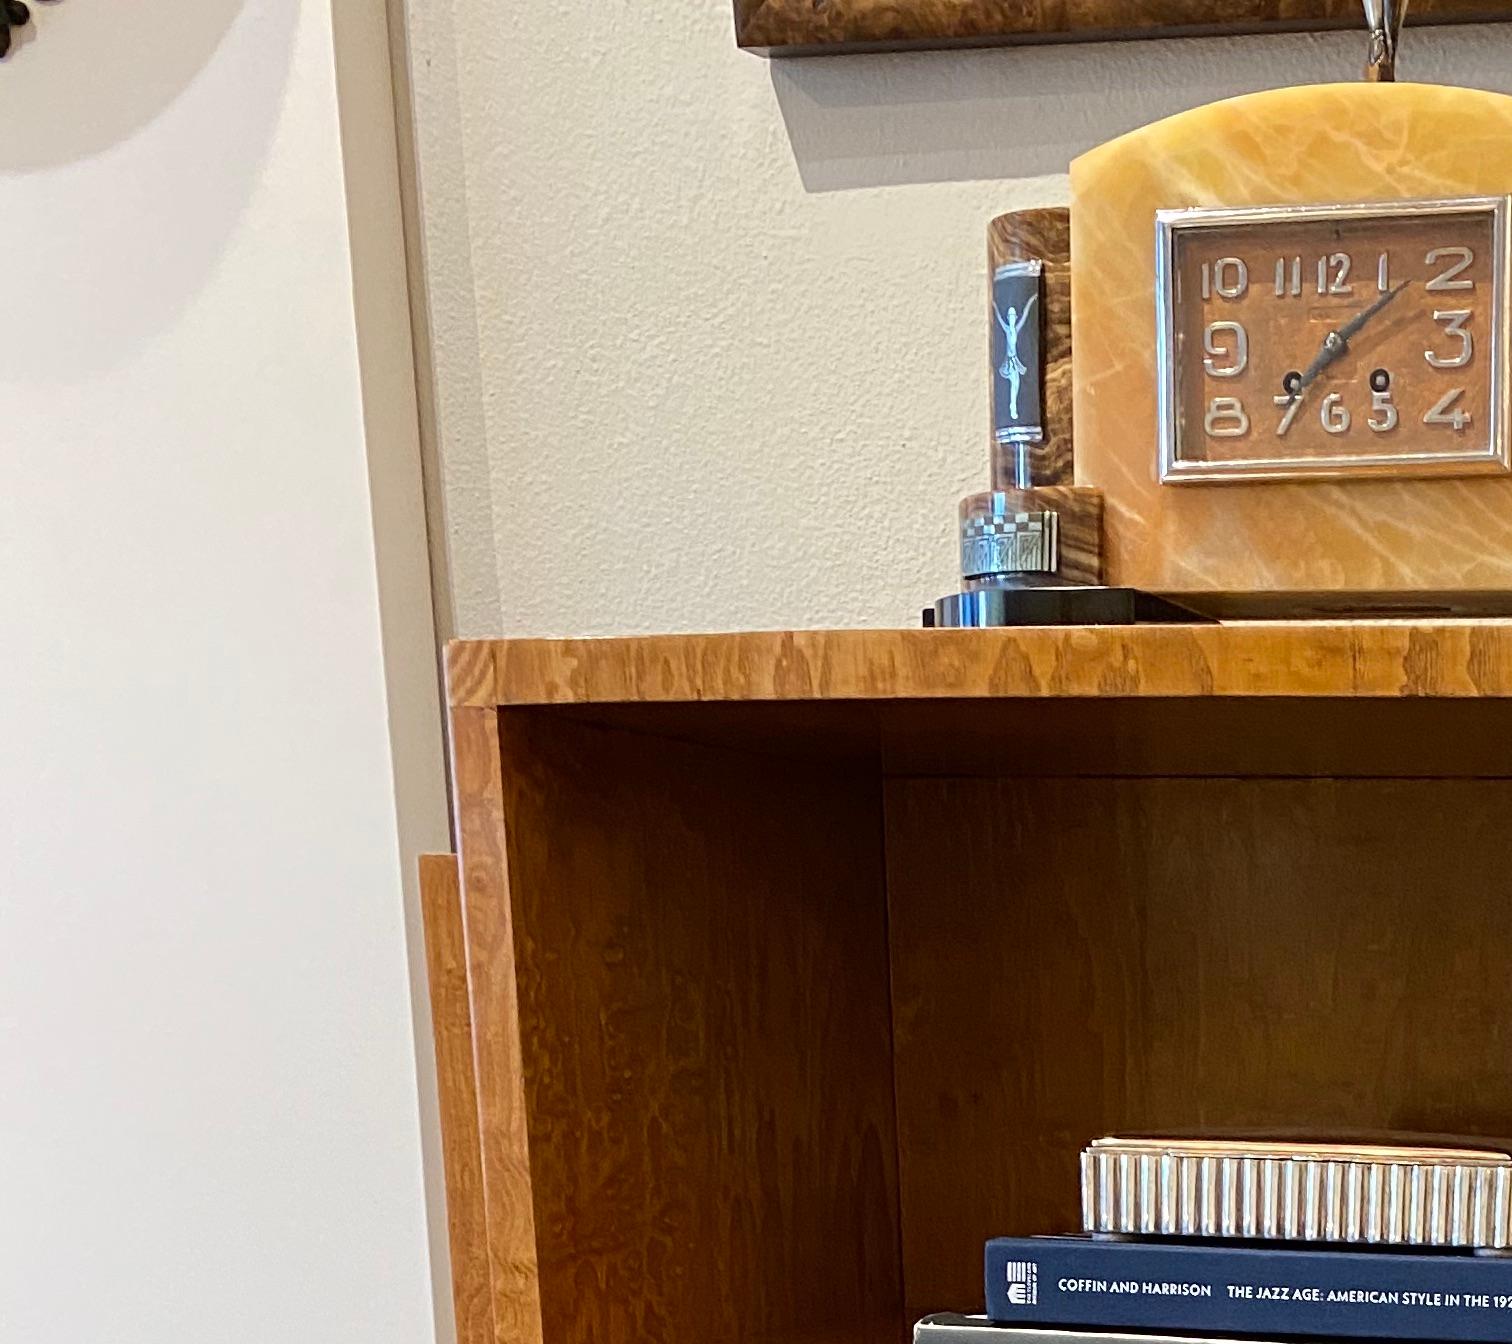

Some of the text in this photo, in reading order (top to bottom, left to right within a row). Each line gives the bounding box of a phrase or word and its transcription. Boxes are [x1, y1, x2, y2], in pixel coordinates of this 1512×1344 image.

[1201, 247, 1474, 299] 10 11 12 1 2
[1203, 321, 1248, 377] 9
[1424, 309, 1473, 368] 3
[1204, 388, 1472, 437] 8 7 6 5 4
[1058, 1278, 1212, 1297] COFFIN AND HARRISON
[1227, 1285, 1253, 1299] THE
[1255, 1287, 1290, 1300] JAZZ
[1292, 1288, 1324, 1302] AGE:
[1327, 1290, 1399, 1305] AMERICAN
[1401, 1291, 1441, 1307] STYLE
[1444, 1294, 1460, 1307] IN
[1463, 1294, 1490, 1308] THE
